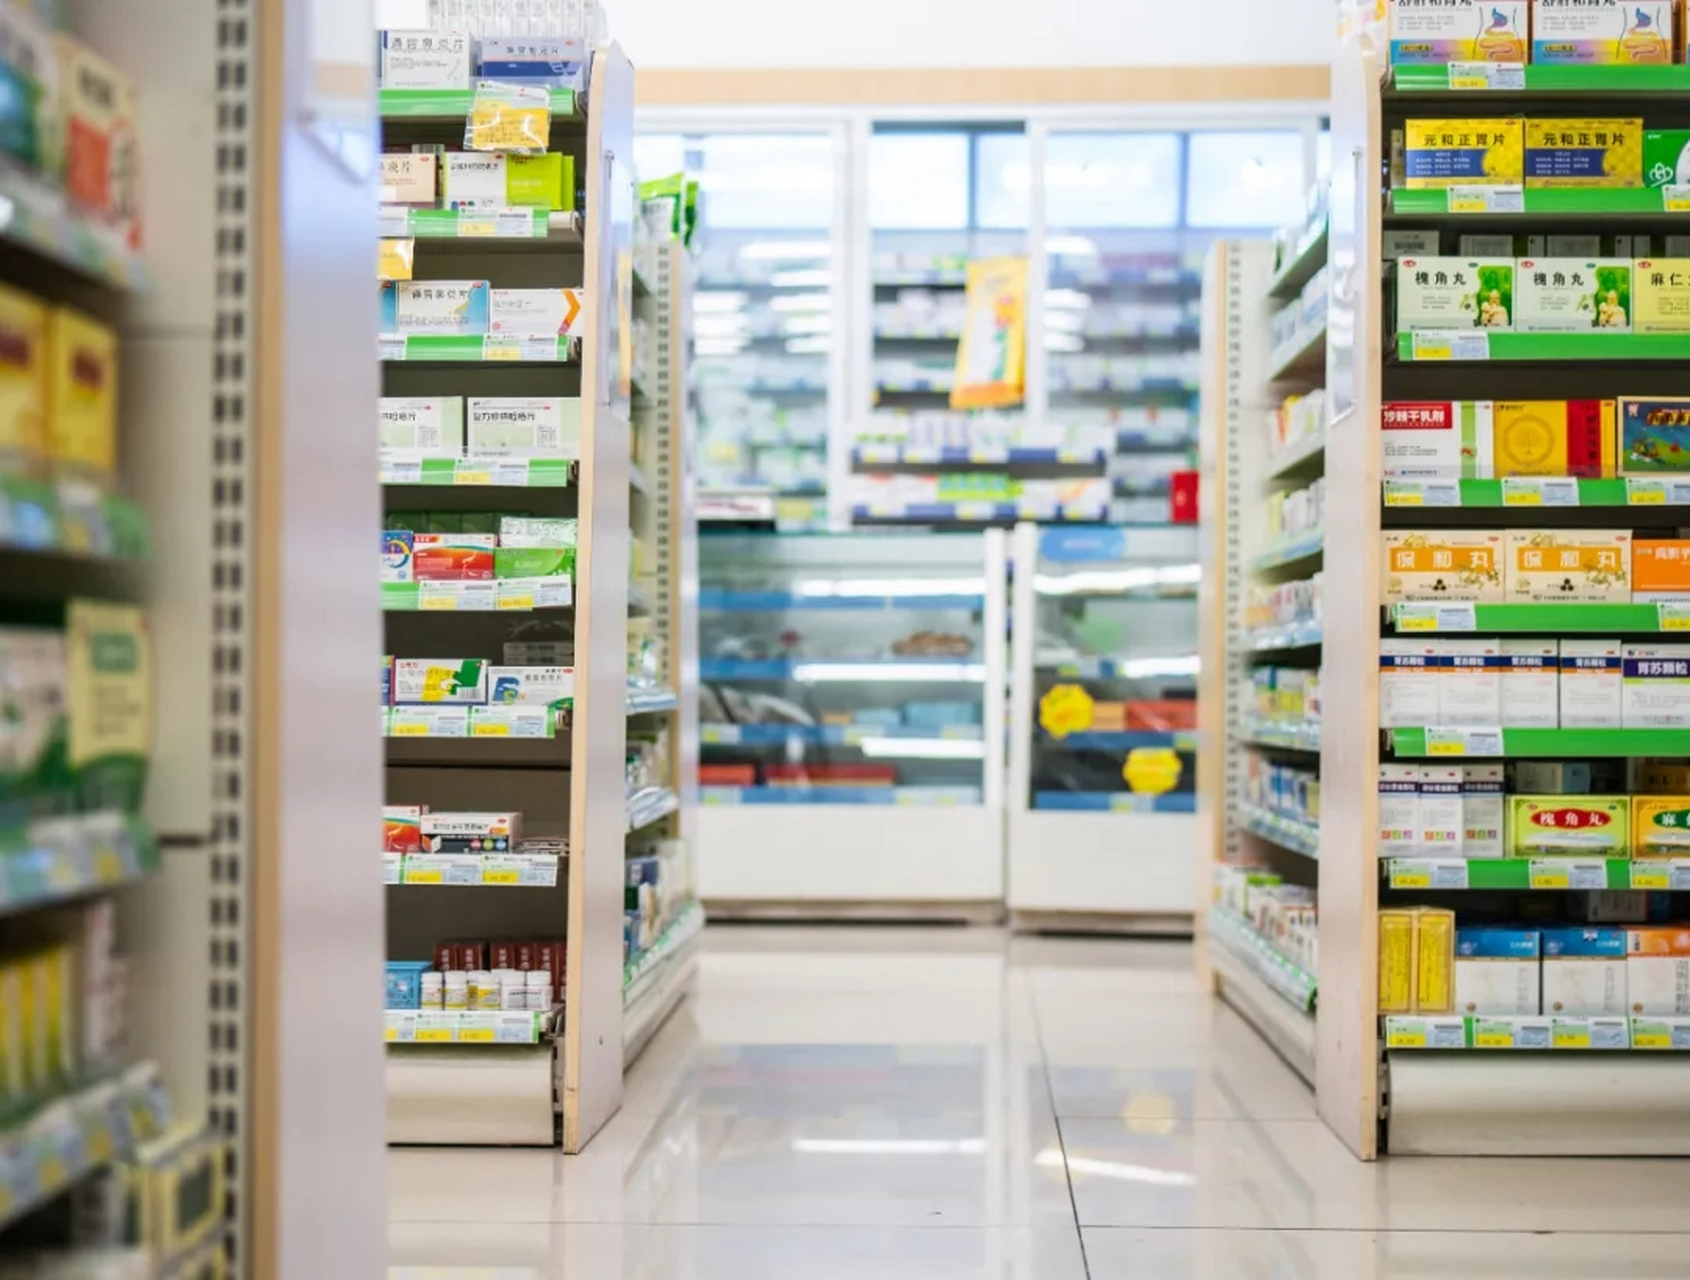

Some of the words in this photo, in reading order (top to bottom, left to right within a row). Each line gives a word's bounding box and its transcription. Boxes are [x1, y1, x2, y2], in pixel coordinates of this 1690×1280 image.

[1424, 133, 1505, 146] 元和正胃片
[1543, 132, 1626, 146] 元和正胃片
[1415, 271, 1466, 285] 槐角丸
[1533, 271, 1585, 286] 槐角丸
[1651, 272, 1690, 286] 麻仁
[1396, 551, 1488, 568] 保和丸
[1523, 551, 1615, 568] 保和丸
[1638, 662, 1688, 676] 胃苏颗粒
[1540, 811, 1604, 826] 槐角丸
